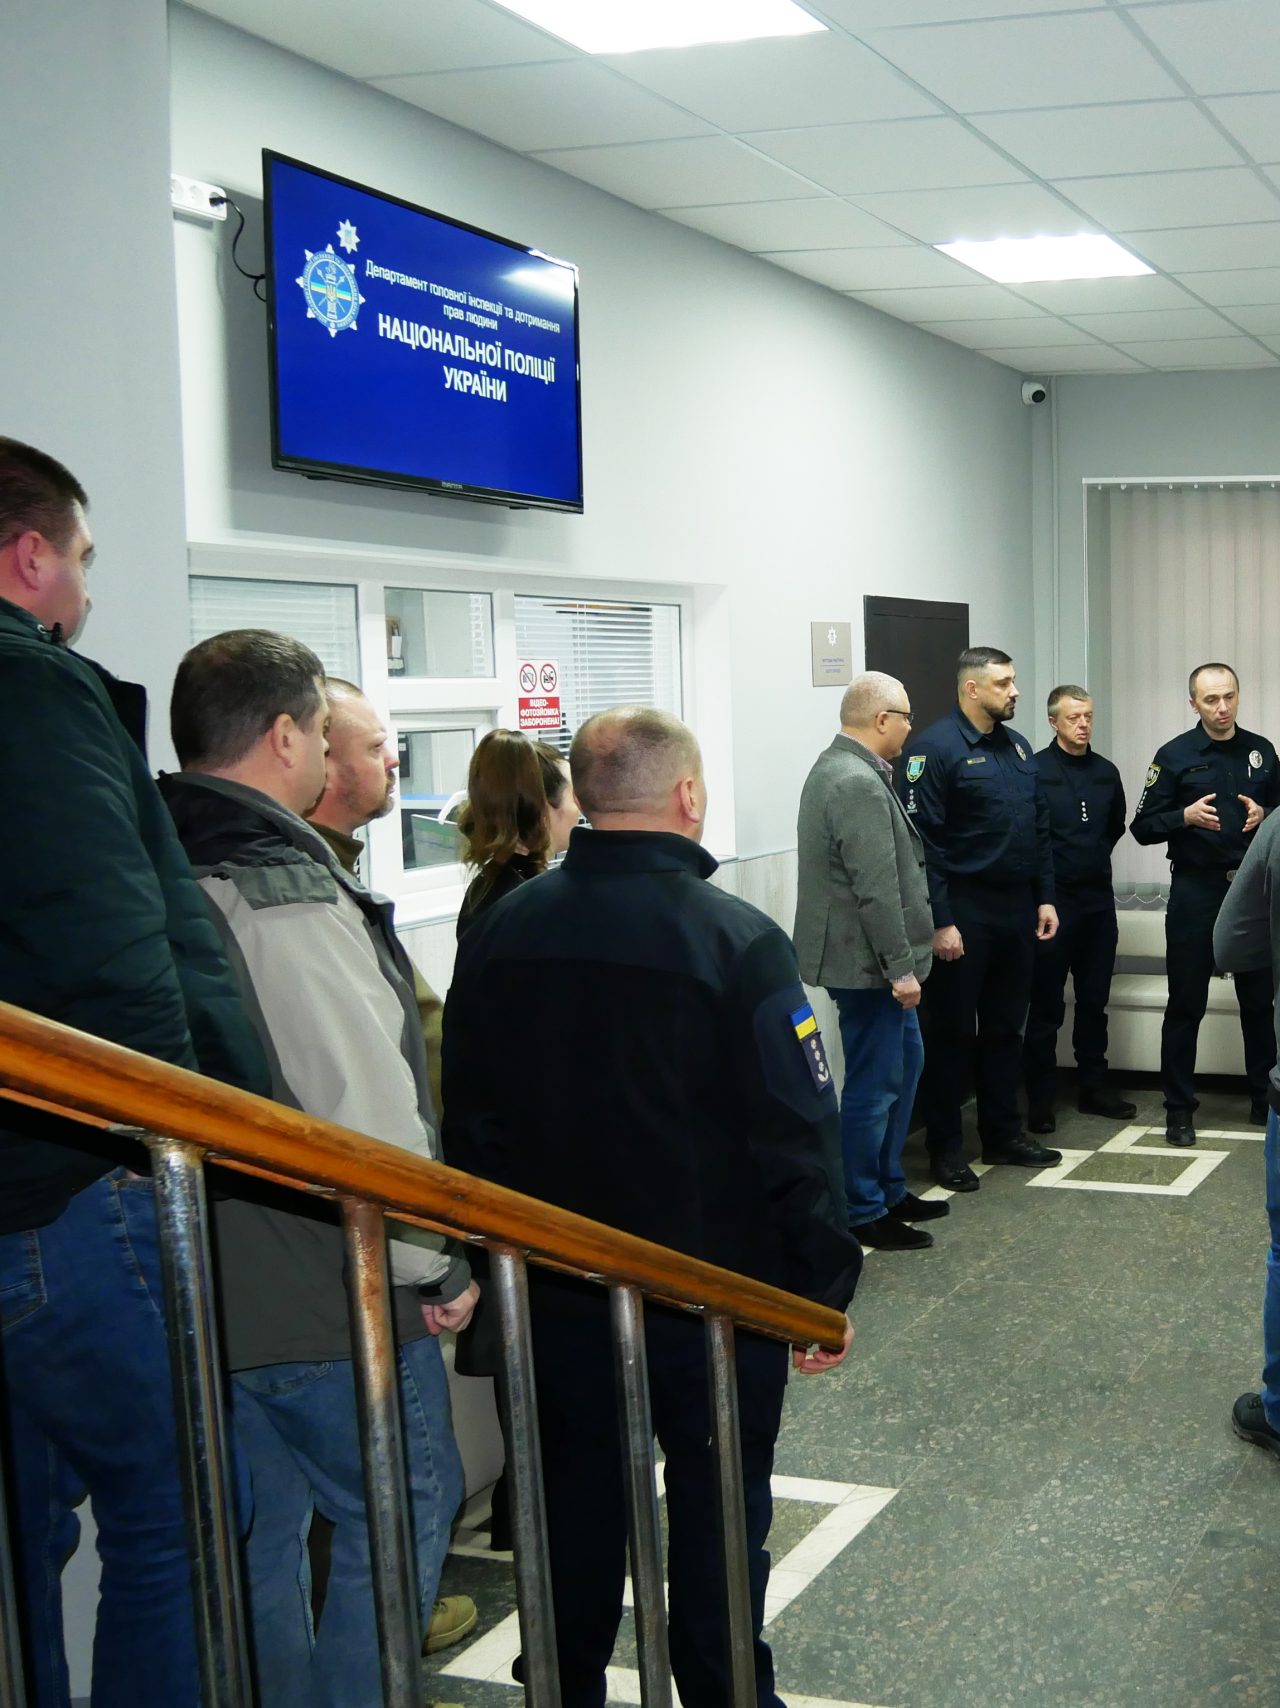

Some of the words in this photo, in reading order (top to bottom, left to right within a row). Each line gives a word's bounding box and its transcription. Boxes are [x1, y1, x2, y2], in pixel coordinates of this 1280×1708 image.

[366, 259, 428, 293] Департамент
[430, 283, 467, 304] головної
[468, 292, 503, 317] інспекції
[504, 307, 514, 319] та
[515, 311, 560, 333] дотримання
[443, 304, 464, 320] прав
[466, 311, 498, 331] людини
[378, 313, 502, 368] НАЦІОНАЛЬНОЇ
[504, 348, 556, 385] ПОЛІЦІЇ
[443, 365, 507, 402] УКРАЇНИ
